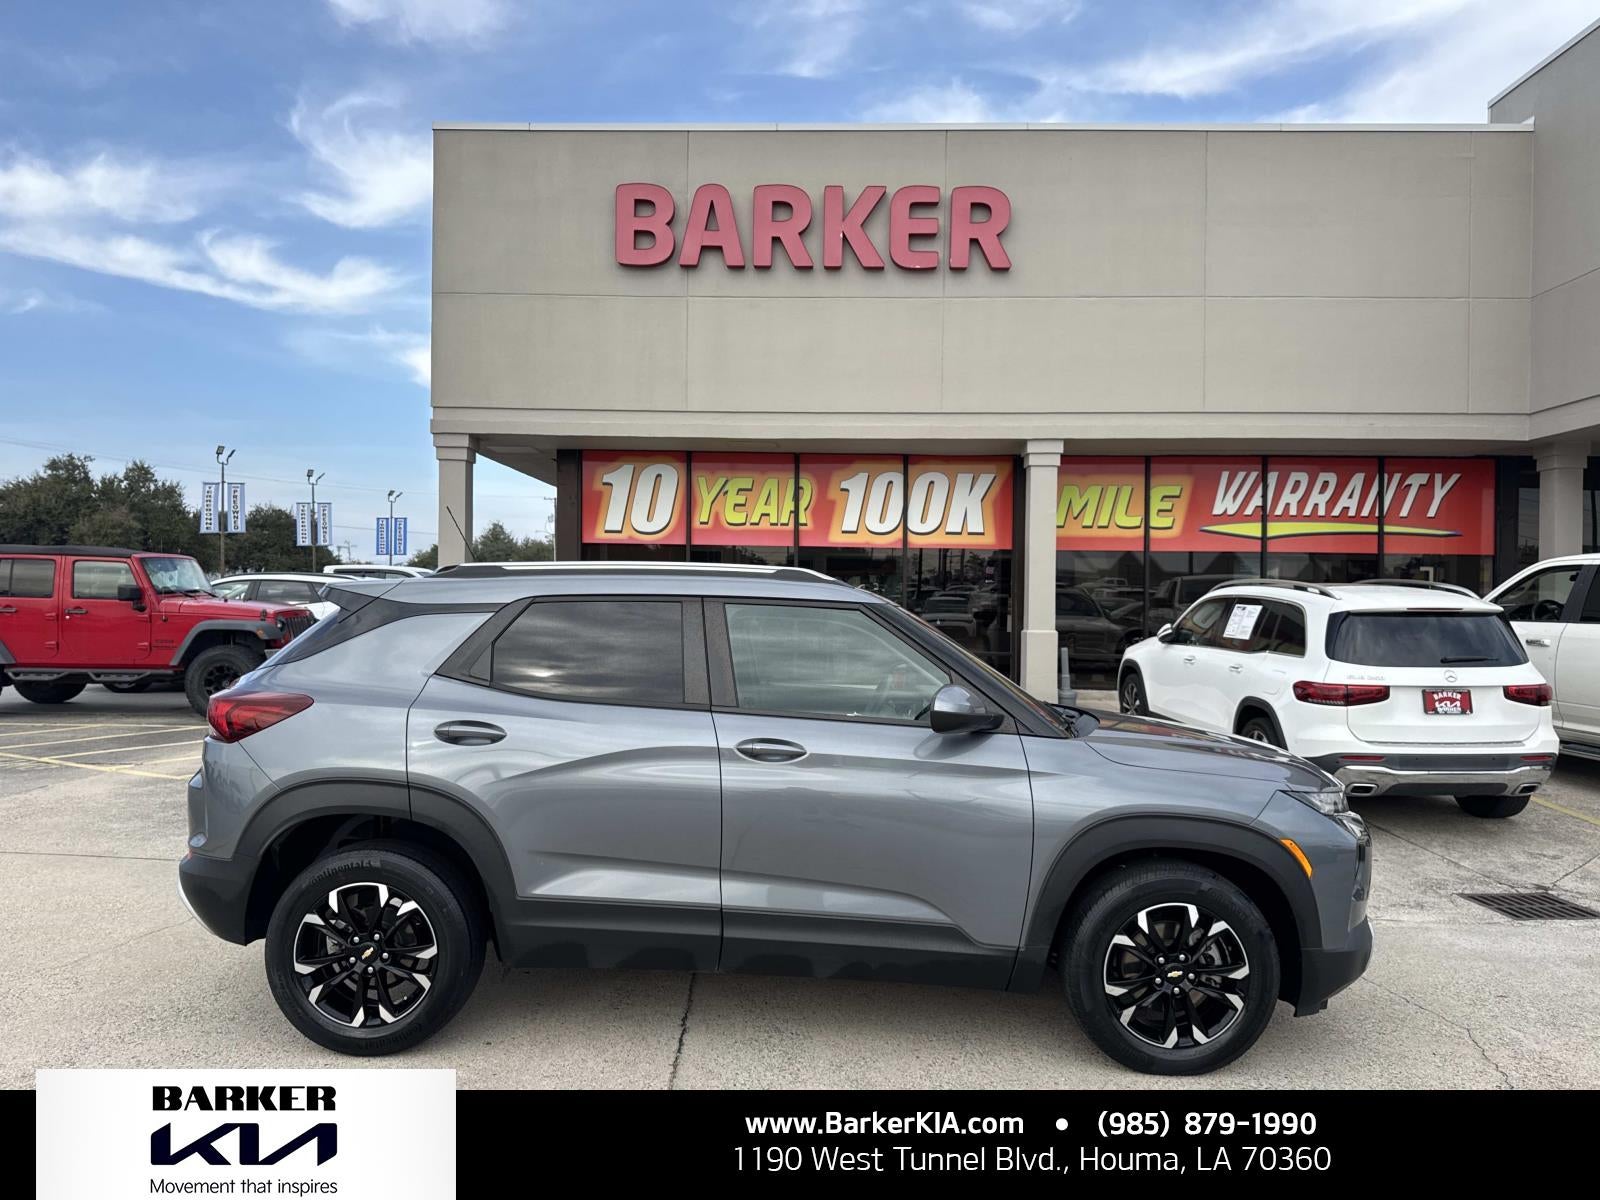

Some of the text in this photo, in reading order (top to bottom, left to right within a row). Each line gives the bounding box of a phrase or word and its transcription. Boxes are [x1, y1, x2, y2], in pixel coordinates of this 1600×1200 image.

[615, 183, 1012, 270] BARKER
[602, 463, 1461, 536] 10 YEAR 100K MILE WARRANTY
[1433, 691, 1461, 700] BARKER
